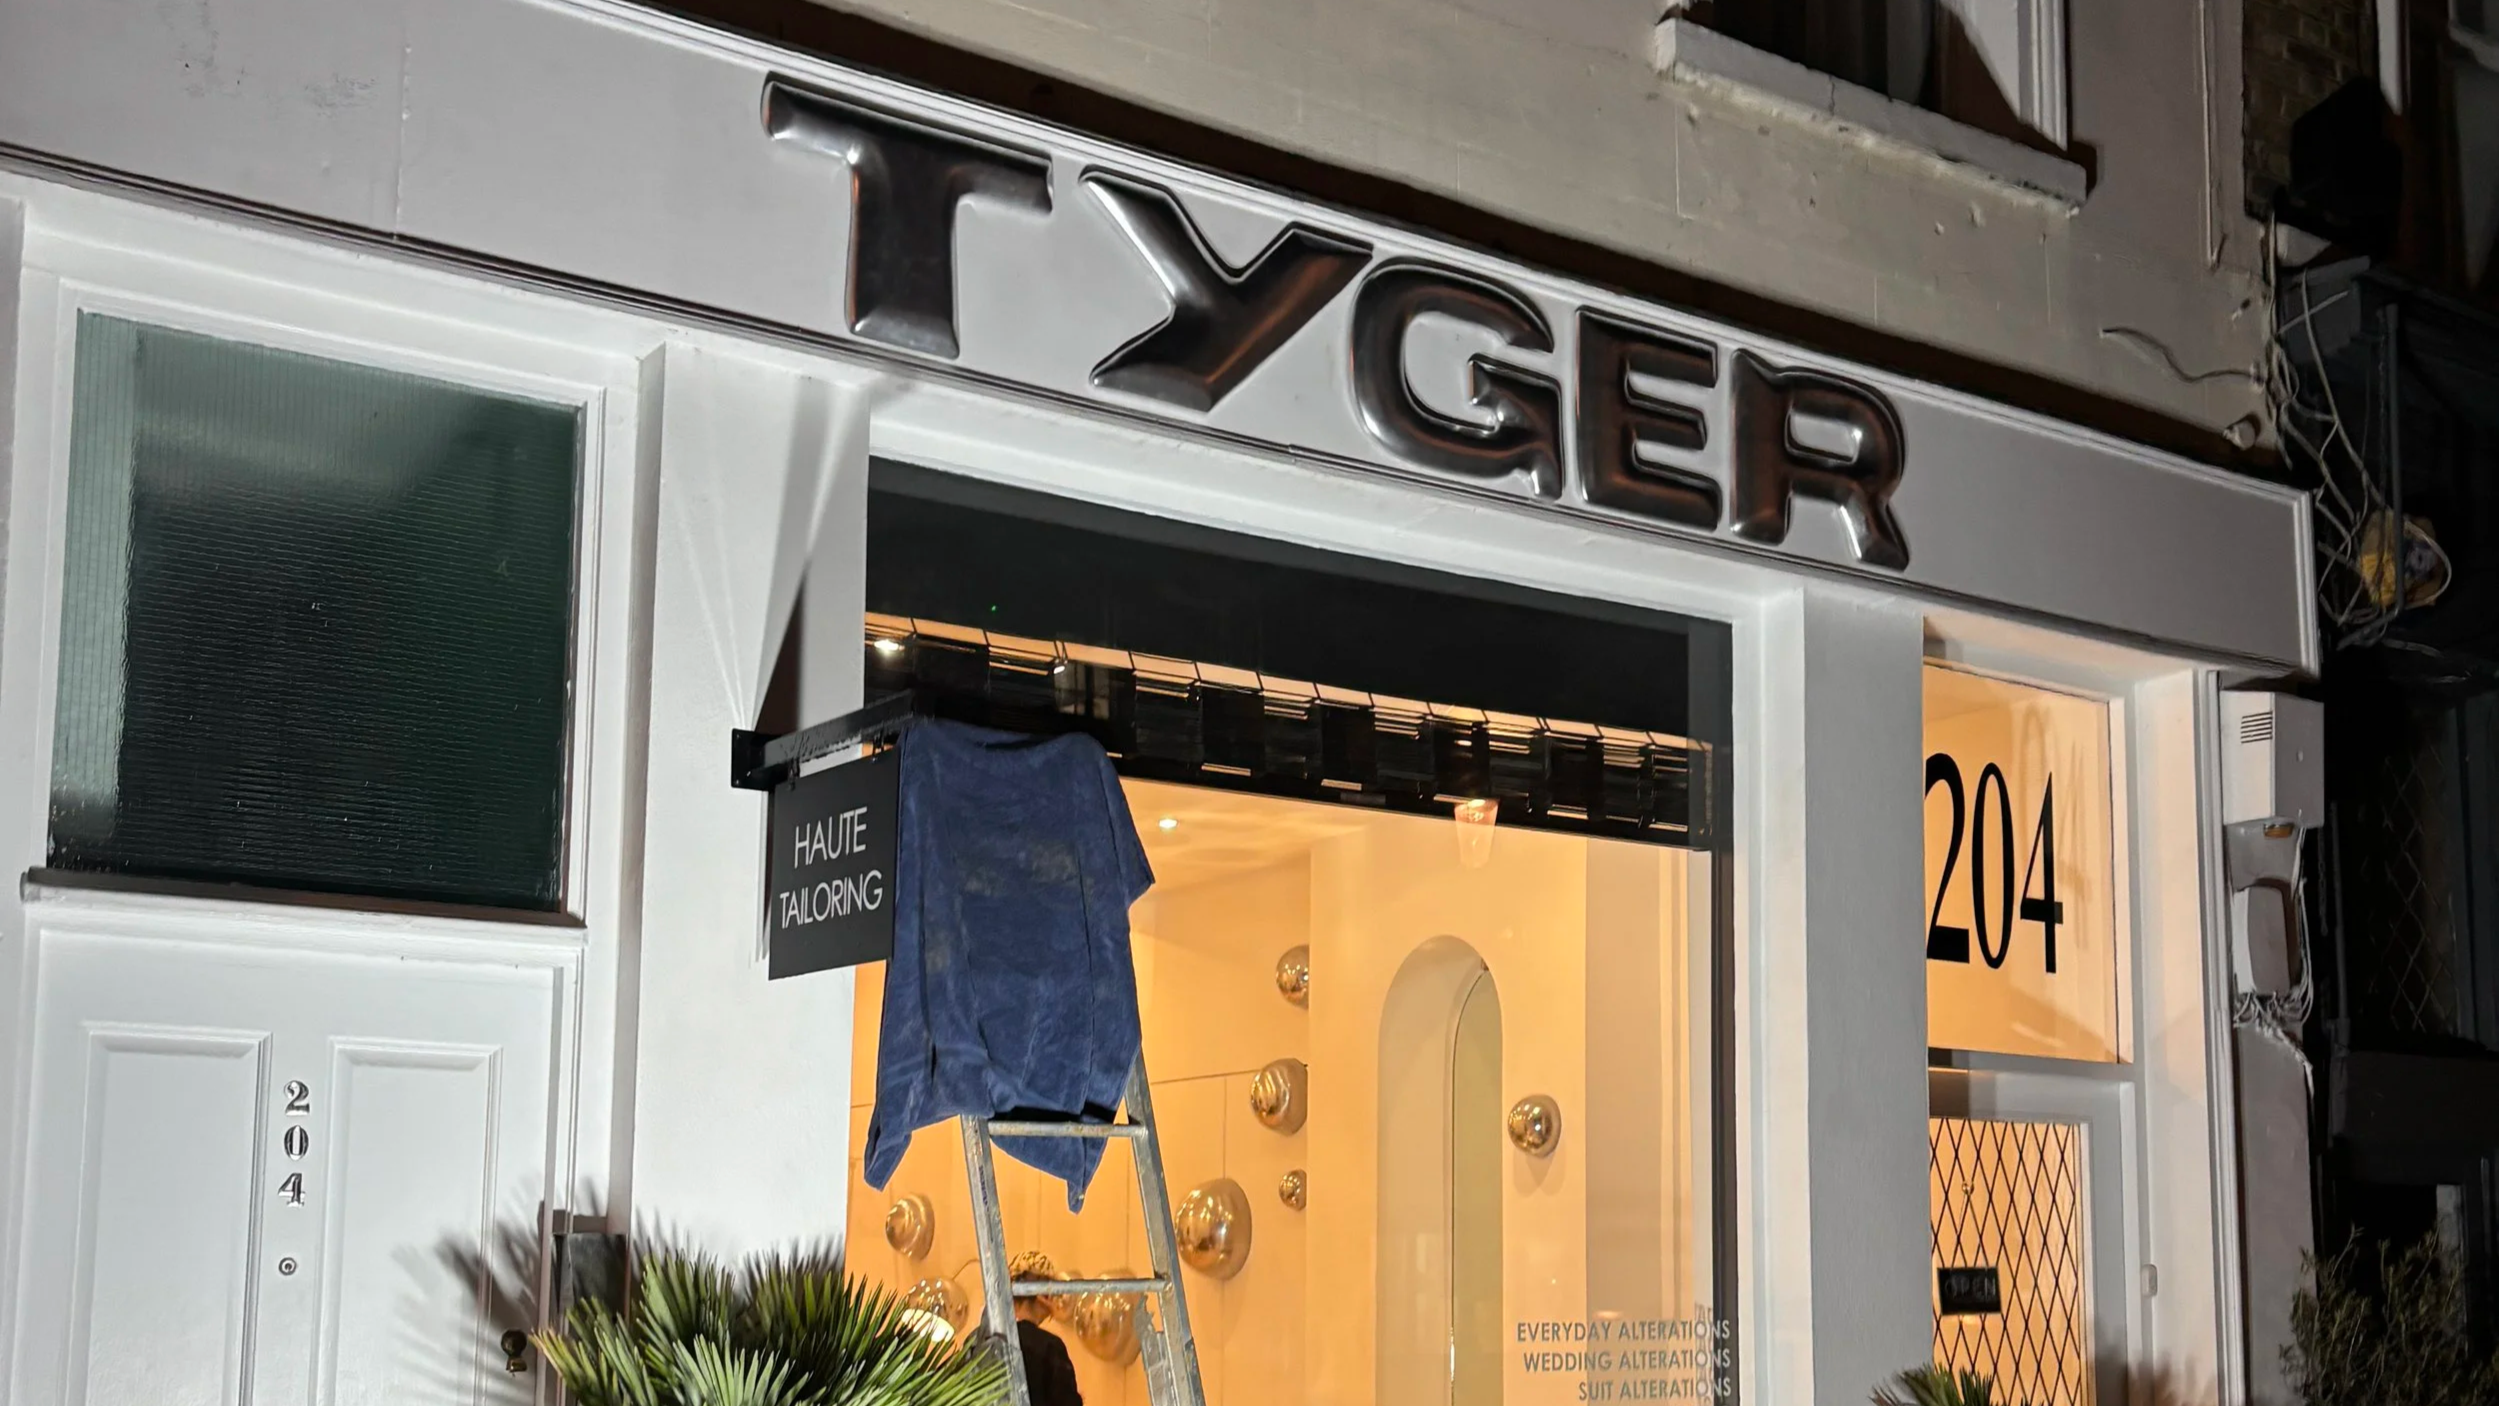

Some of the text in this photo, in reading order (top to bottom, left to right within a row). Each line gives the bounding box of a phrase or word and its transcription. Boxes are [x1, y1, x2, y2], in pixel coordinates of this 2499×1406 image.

[760, 71, 1911, 574] TYGER
[794, 806, 868, 869] HAUTE
[1924, 752, 2064, 974] 204
[780, 869, 883, 930] TAILORING
[1516, 1319, 1731, 1343] EVERYDAY ALTERATIONS
[1523, 1348, 1731, 1373] WEDDING ALTERATIONS
[1578, 1376, 1732, 1401] SUIT ALTERATIONS
